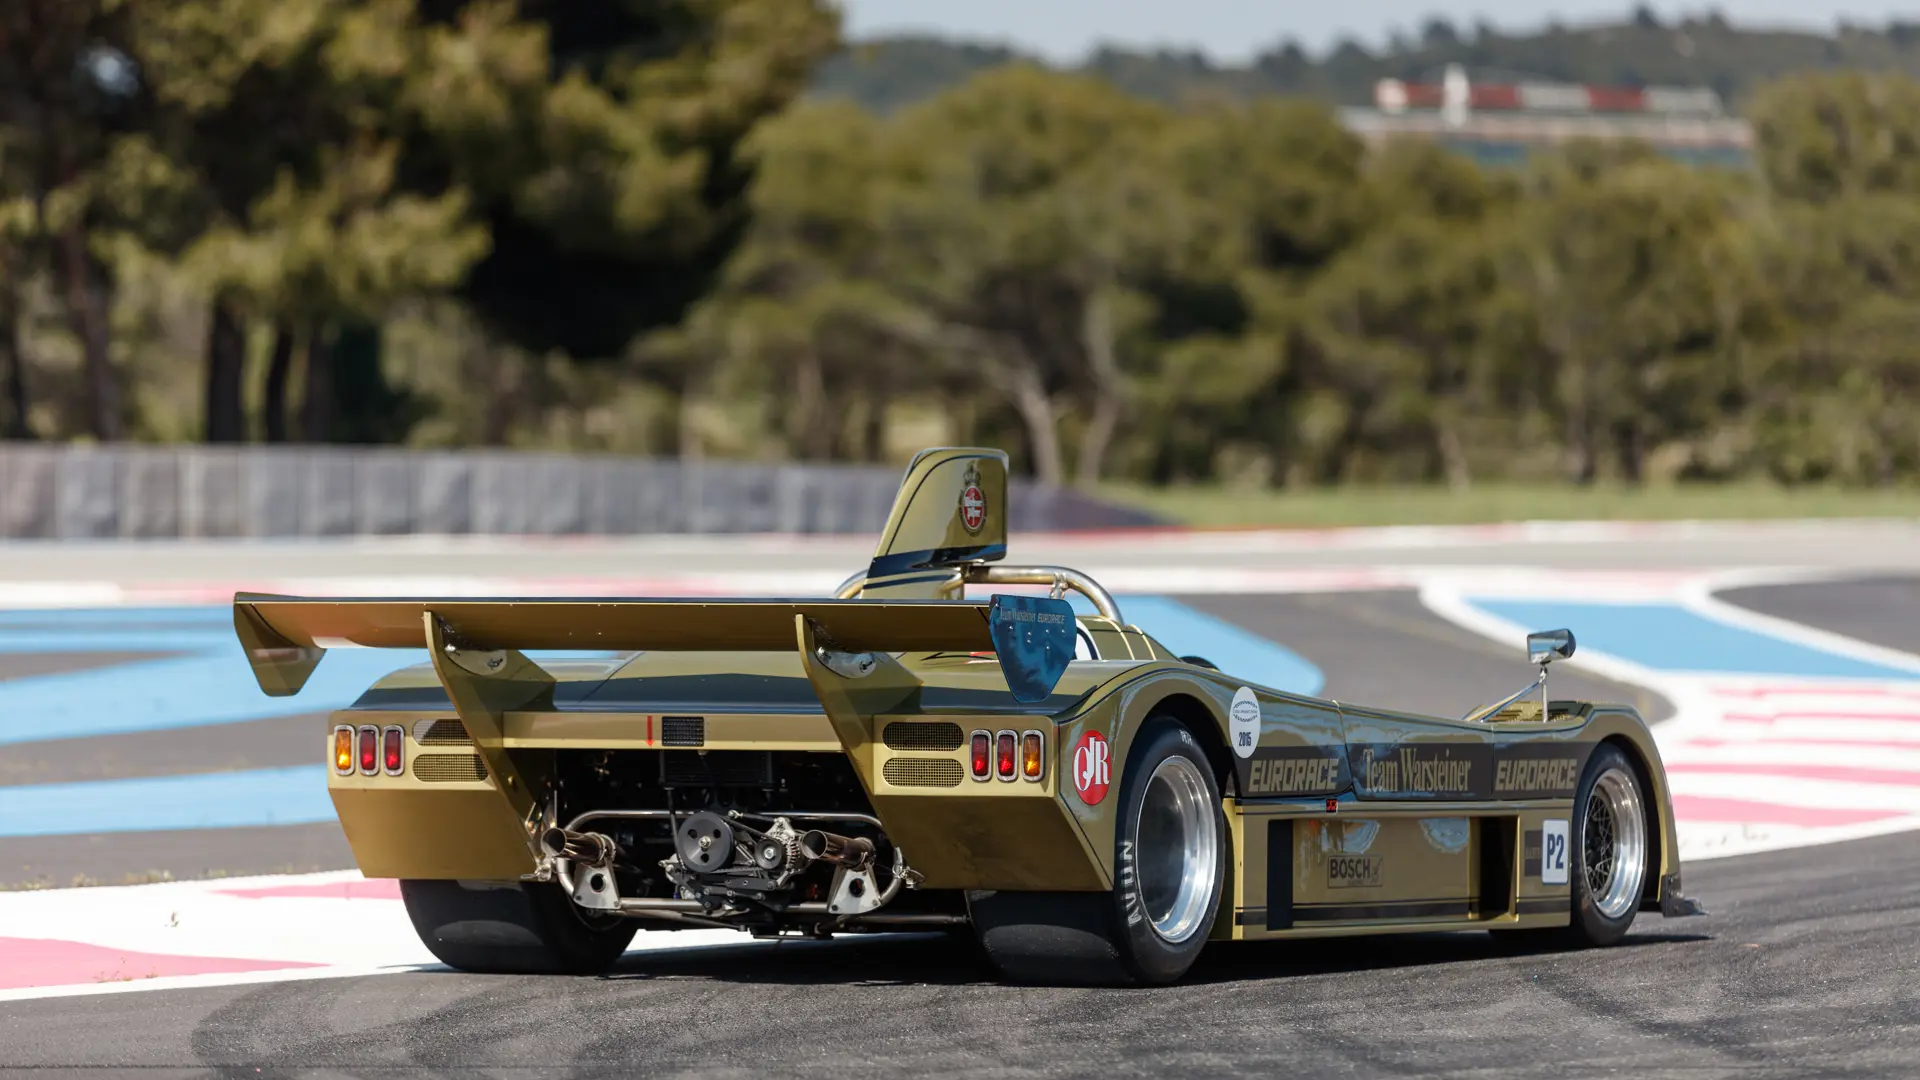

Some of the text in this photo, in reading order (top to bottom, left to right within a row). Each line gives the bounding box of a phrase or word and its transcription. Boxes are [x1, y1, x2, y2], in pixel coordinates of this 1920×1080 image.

[1248, 758, 1340, 792] EURORACE
[1362, 747, 1472, 793] Team Warsteiner
[1494, 758, 1578, 791] EURORACE
[1329, 858, 1371, 879] BOSCH
[1546, 833, 1565, 870] P2
